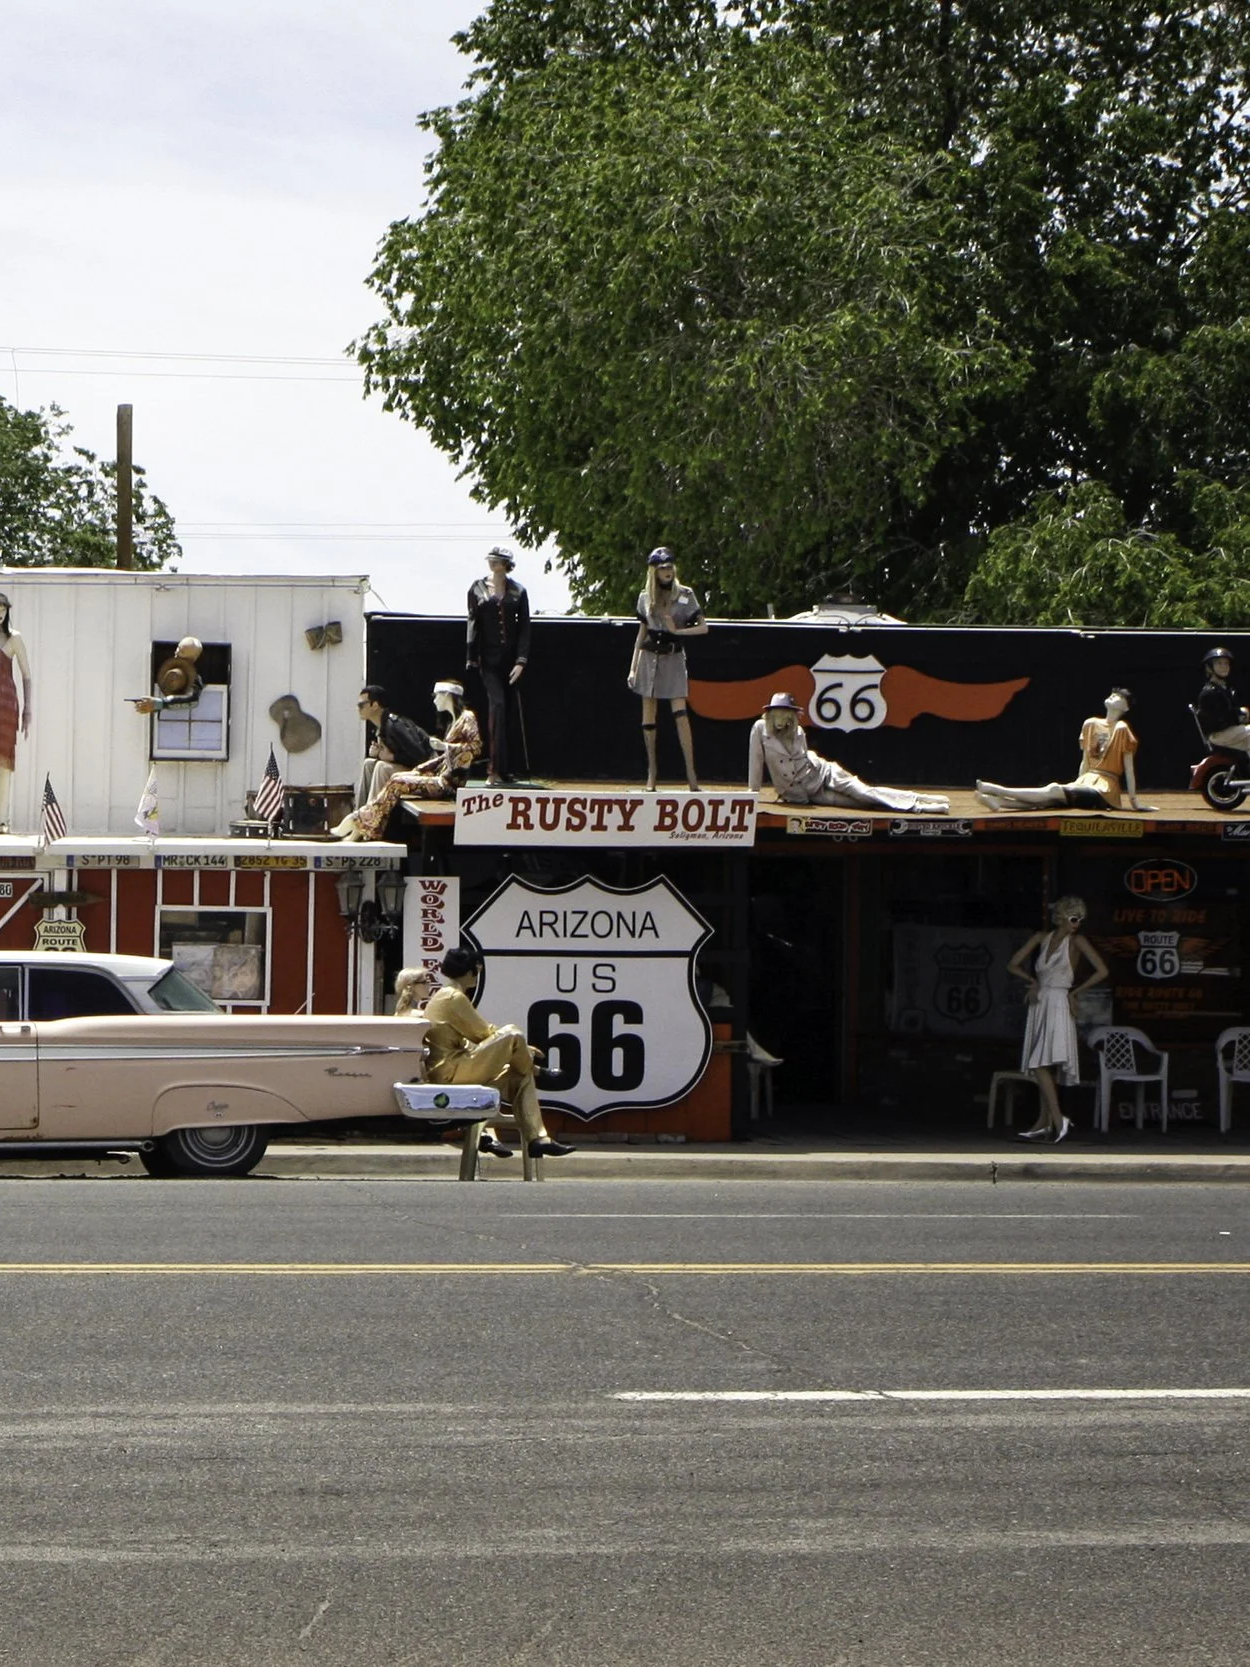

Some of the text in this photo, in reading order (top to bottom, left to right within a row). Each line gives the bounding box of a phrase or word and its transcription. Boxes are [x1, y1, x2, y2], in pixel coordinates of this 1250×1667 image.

[816, 682, 879, 723] 66
[461, 792, 755, 833] The RUSTY BOLT
[1130, 868, 1191, 893] OPEN
[43, 925, 77, 934] ARIZONA
[418, 880, 448, 952] WORLD
[515, 909, 660, 939] ARIZONA
[1113, 908, 1207, 925] LIVE TO RIDE
[42, 938, 78, 946] ROUTE
[1143, 934, 1175, 944] ROUTE
[1141, 949, 1175, 975] 66
[947, 986, 981, 1014] 66
[527, 999, 645, 1092] 66
